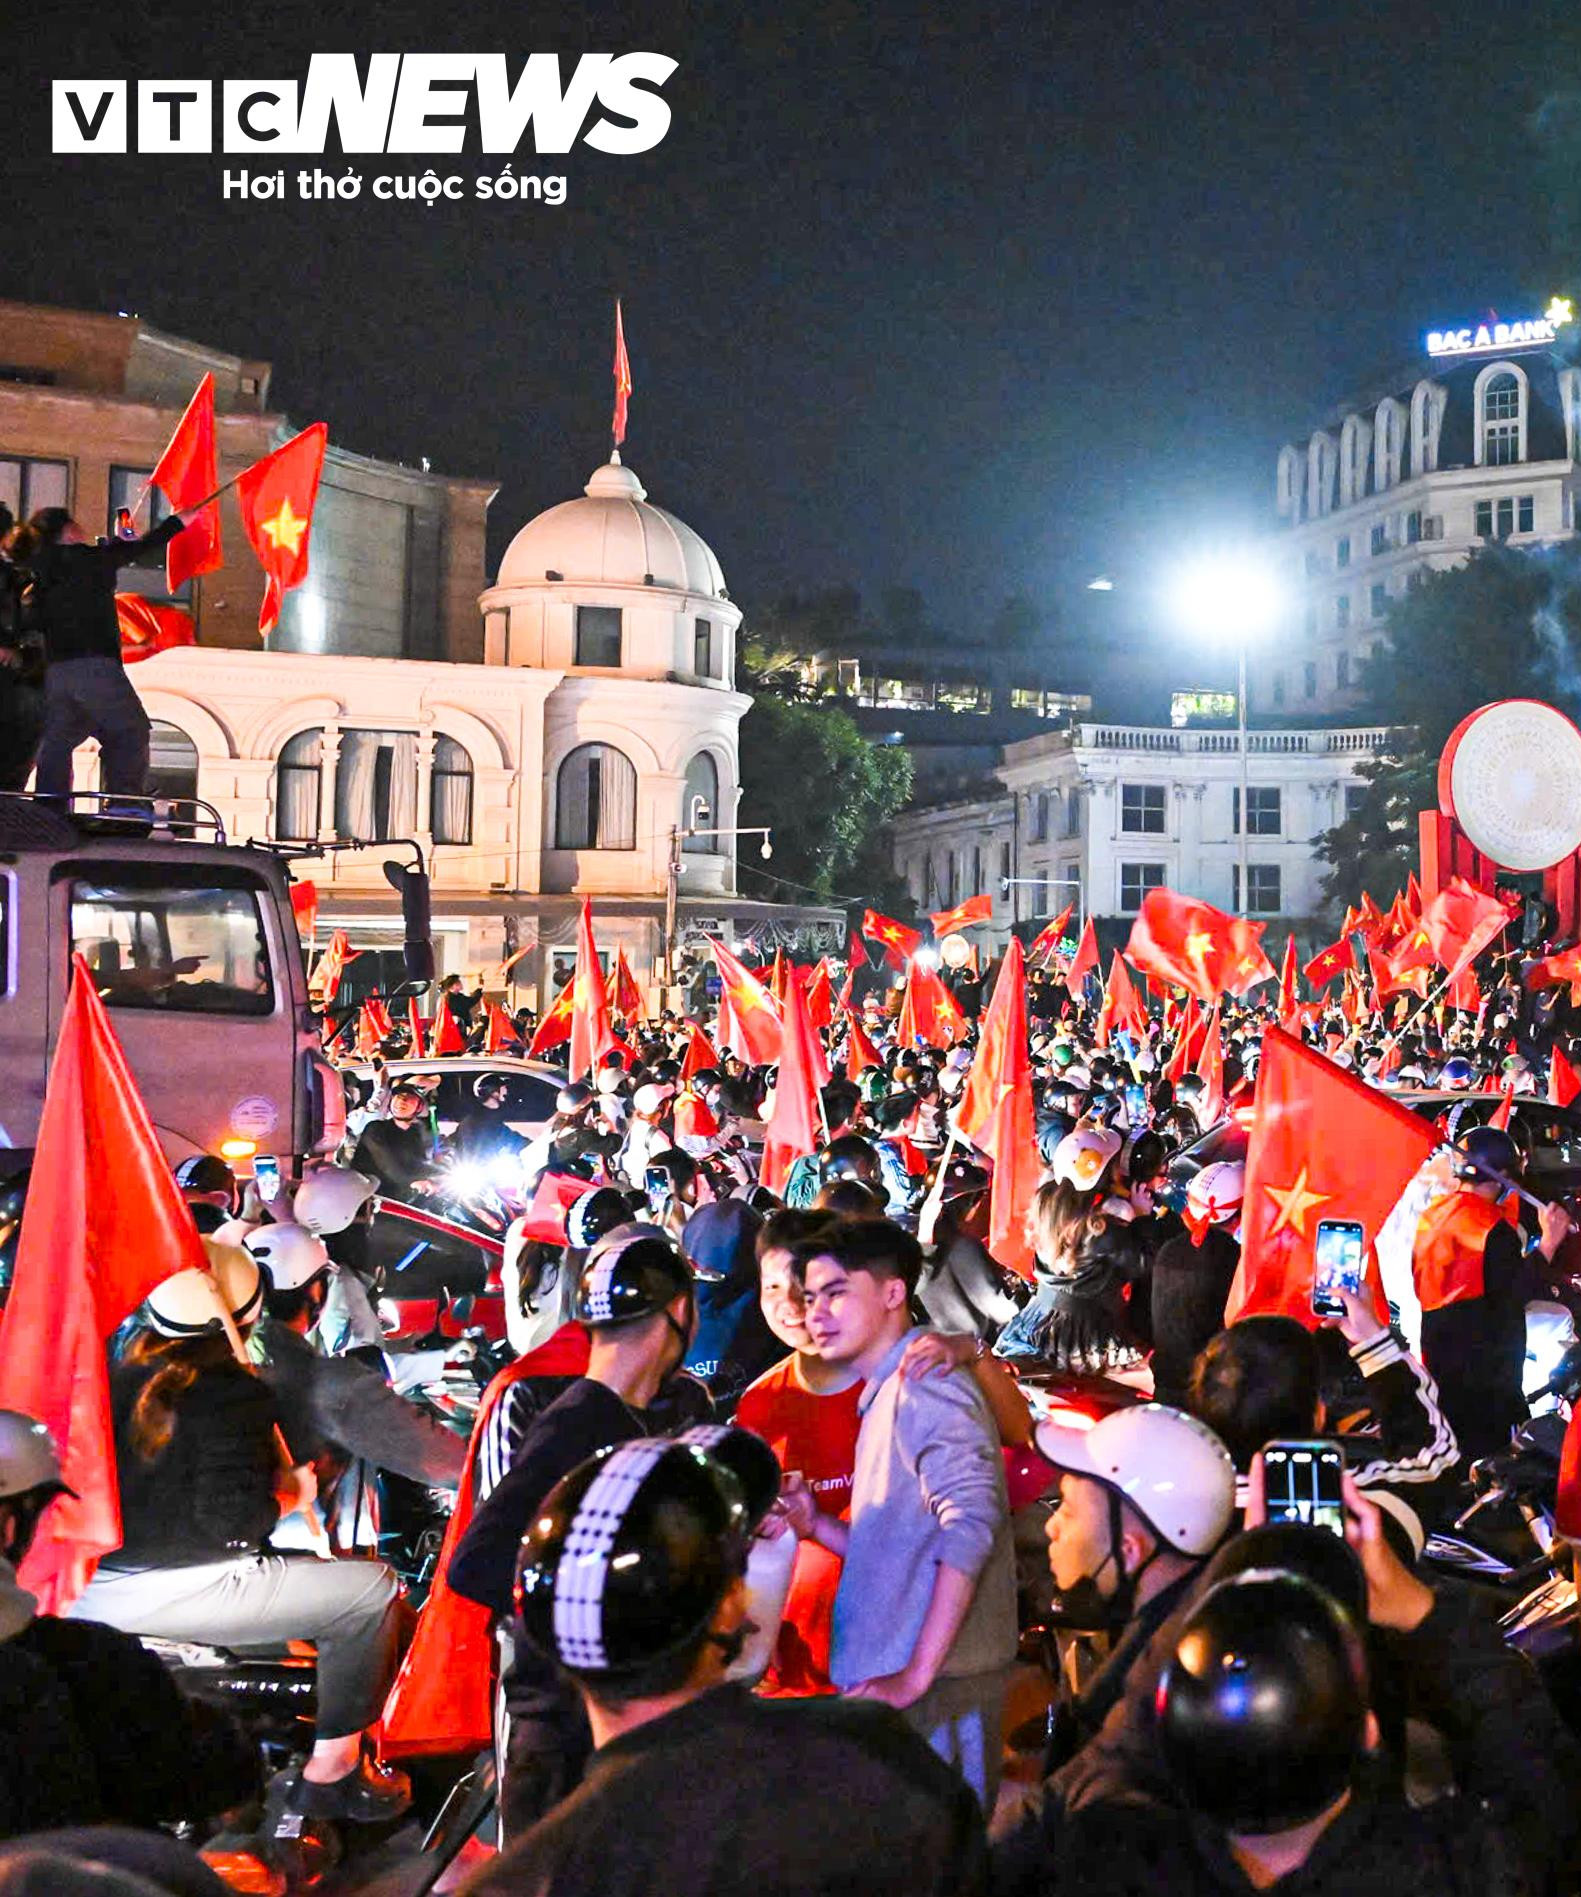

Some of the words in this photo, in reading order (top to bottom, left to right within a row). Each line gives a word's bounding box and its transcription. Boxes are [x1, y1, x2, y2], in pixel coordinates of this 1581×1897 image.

[1427, 328, 1472, 352] BAC
[1494, 318, 1556, 344] BANK
[686, 1360, 719, 1377] SU
[804, 1472, 857, 1494] TeamV
